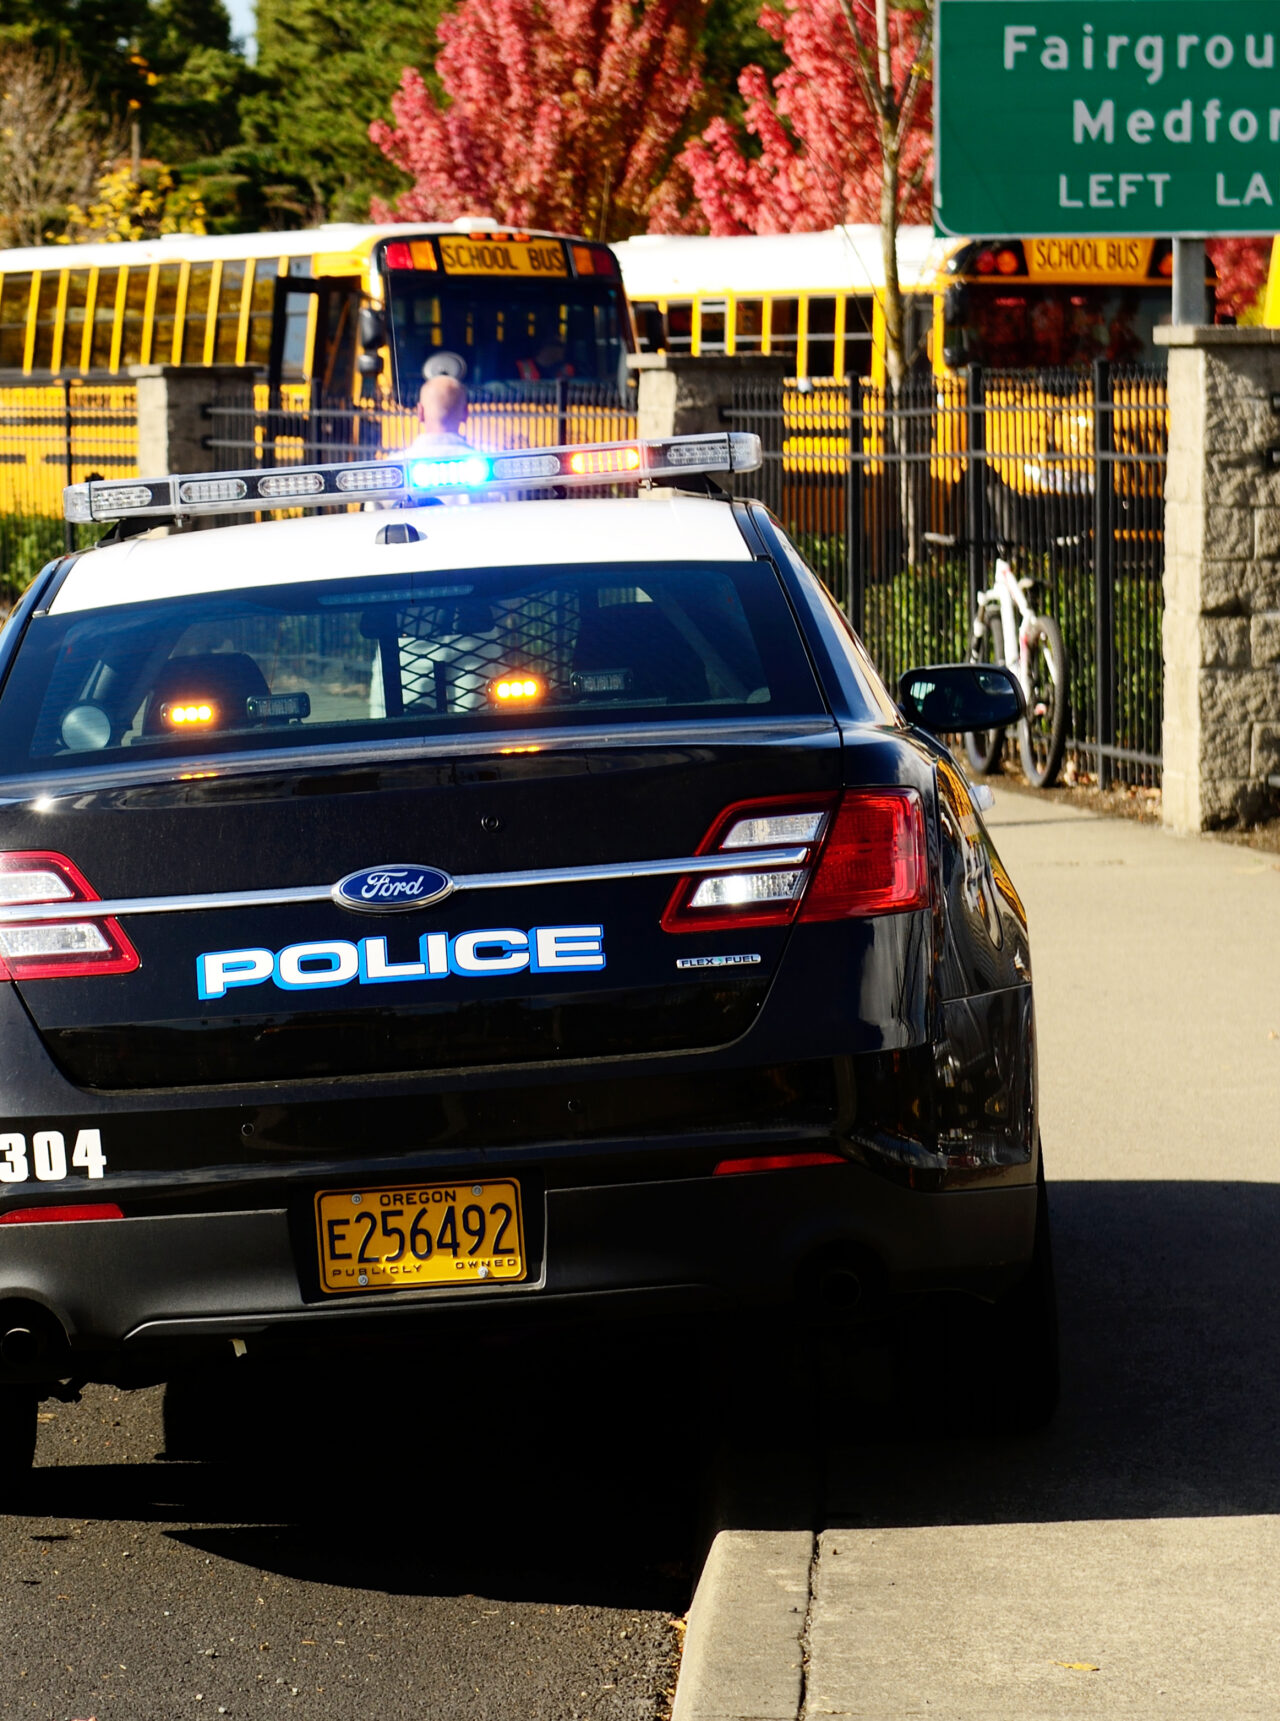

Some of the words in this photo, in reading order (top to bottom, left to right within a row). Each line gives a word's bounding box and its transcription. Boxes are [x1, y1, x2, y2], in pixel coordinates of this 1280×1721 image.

[1003, 23, 1274, 85] Fairgrou
[1059, 173, 1170, 208] LEFT
[1216, 172, 1273, 206] LA
[440, 243, 519, 270] SCHOOL
[527, 246, 567, 271] BUS
[1036, 240, 1104, 271] SCHOOL
[1106, 241, 1139, 271] BUS
[361, 871, 424, 898] Ford
[196, 924, 606, 1000] POLICE
[681, 959, 714, 968] FLEX
[725, 955, 758, 964] FUEL
[379, 1189, 457, 1207] OREGON
[327, 1202, 515, 1264] E256492
[332, 1264, 422, 1277] PUBLICLY
[455, 1258, 517, 1270] OWNED
